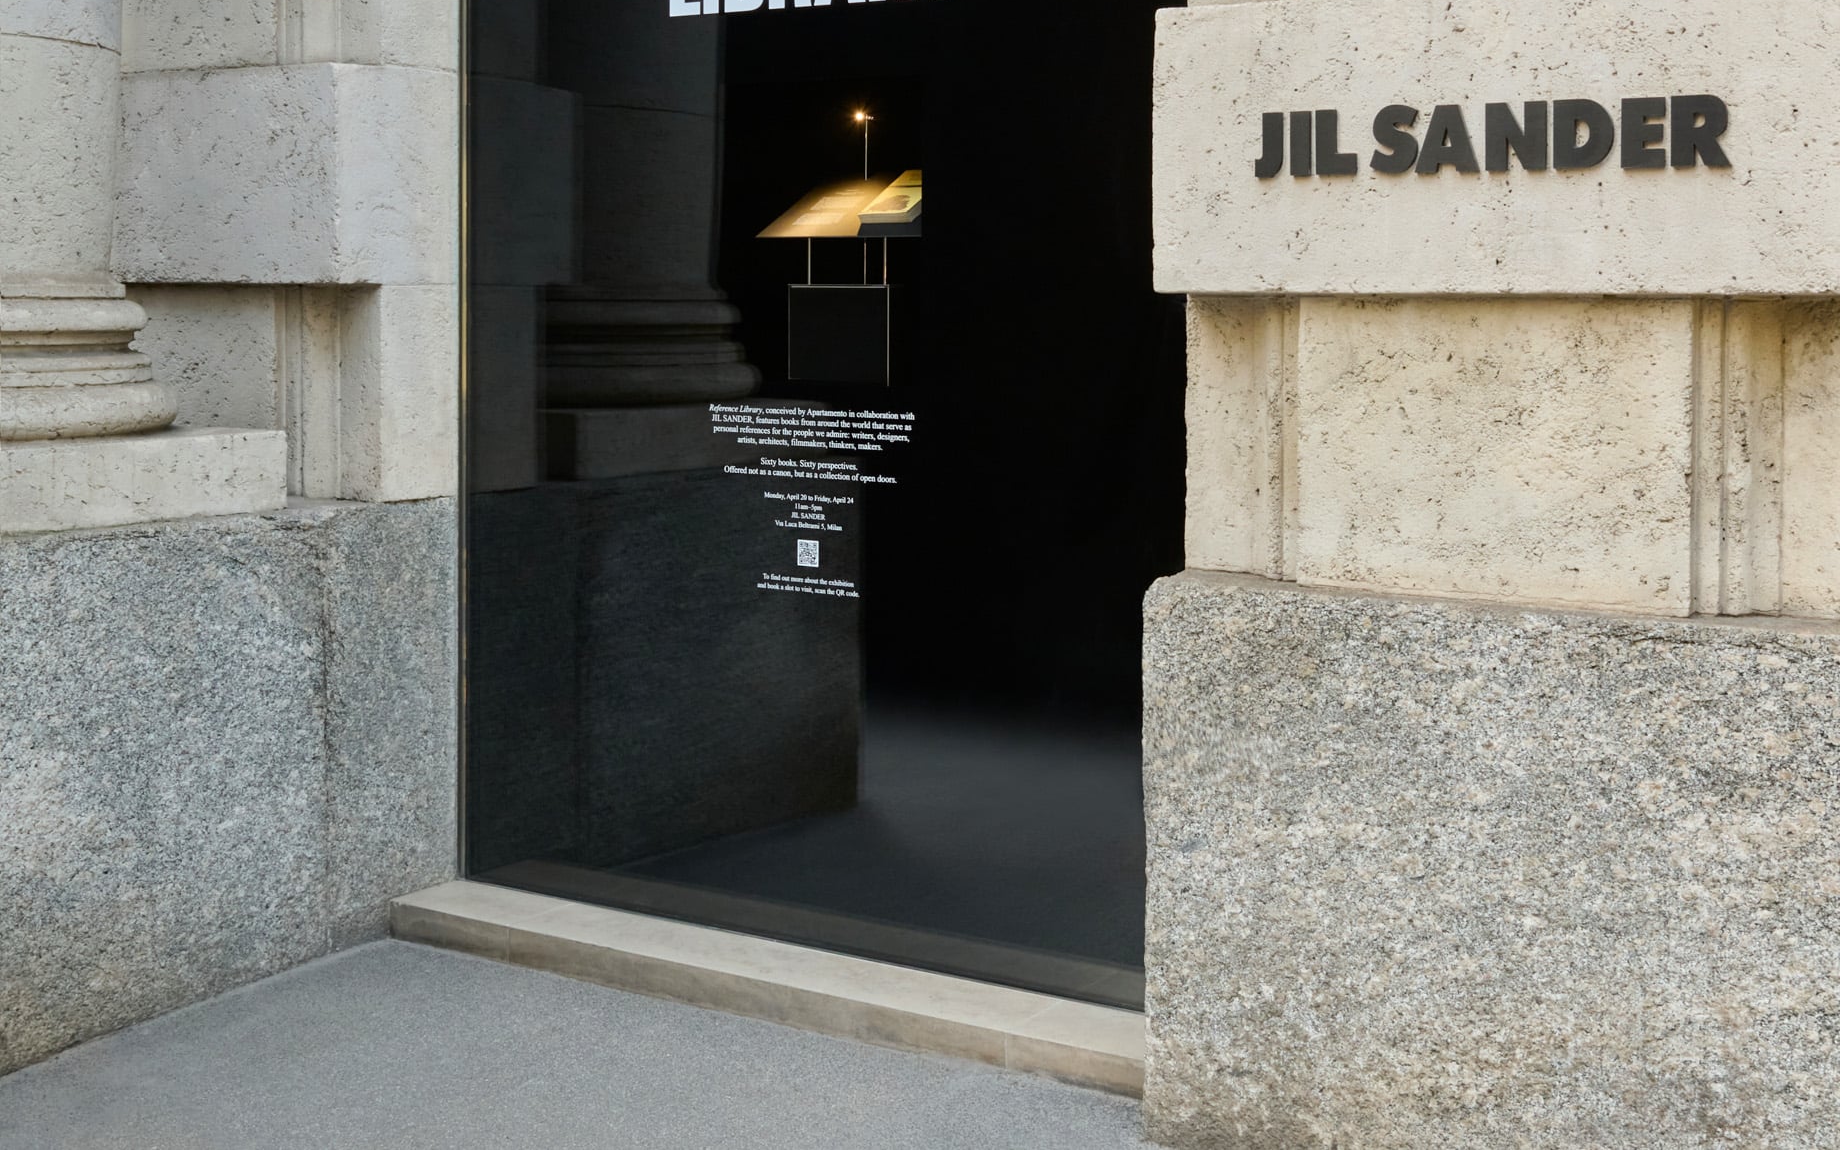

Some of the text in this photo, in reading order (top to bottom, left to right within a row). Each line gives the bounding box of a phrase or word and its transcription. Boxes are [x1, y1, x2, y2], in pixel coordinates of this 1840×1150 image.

[709, 404, 738, 413] Reference
[740, 405, 764, 415] Library,
[766, 407, 796, 415] conceived
[798, 407, 805, 417] by
[807, 408, 847, 418] Apartamento
[856, 410, 898, 419] collaboration
[900, 412, 915, 420] with
[723, 415, 754, 424] SANDER,
[781, 417, 799, 425] books
[801, 418, 816, 426] from
[840, 420, 850, 428] the
[852, 421, 870, 429] world
[740, 426, 770, 434] references
[772, 427, 781, 435] for
[793, 429, 814, 438] people
[826, 430, 849, 438] admire:
[852, 431, 876, 440] writers,
[877, 432, 909, 442] designers,
[737, 436, 883, 450] artists, architects, filmmakers, thinkers, makers.
[761, 457, 857, 471] Sixty books. Sixty perspectives.
[724, 465, 747, 474] Offered
[819, 472, 850, 480] collection
[852, 473, 859, 481] of
[877, 475, 897, 483] doors.
[764, 492, 785, 500] Monday,
[786, 493, 799, 501] April
[814, 495, 832, 503] Friday,
[801, 586, 813, 594] visit,
